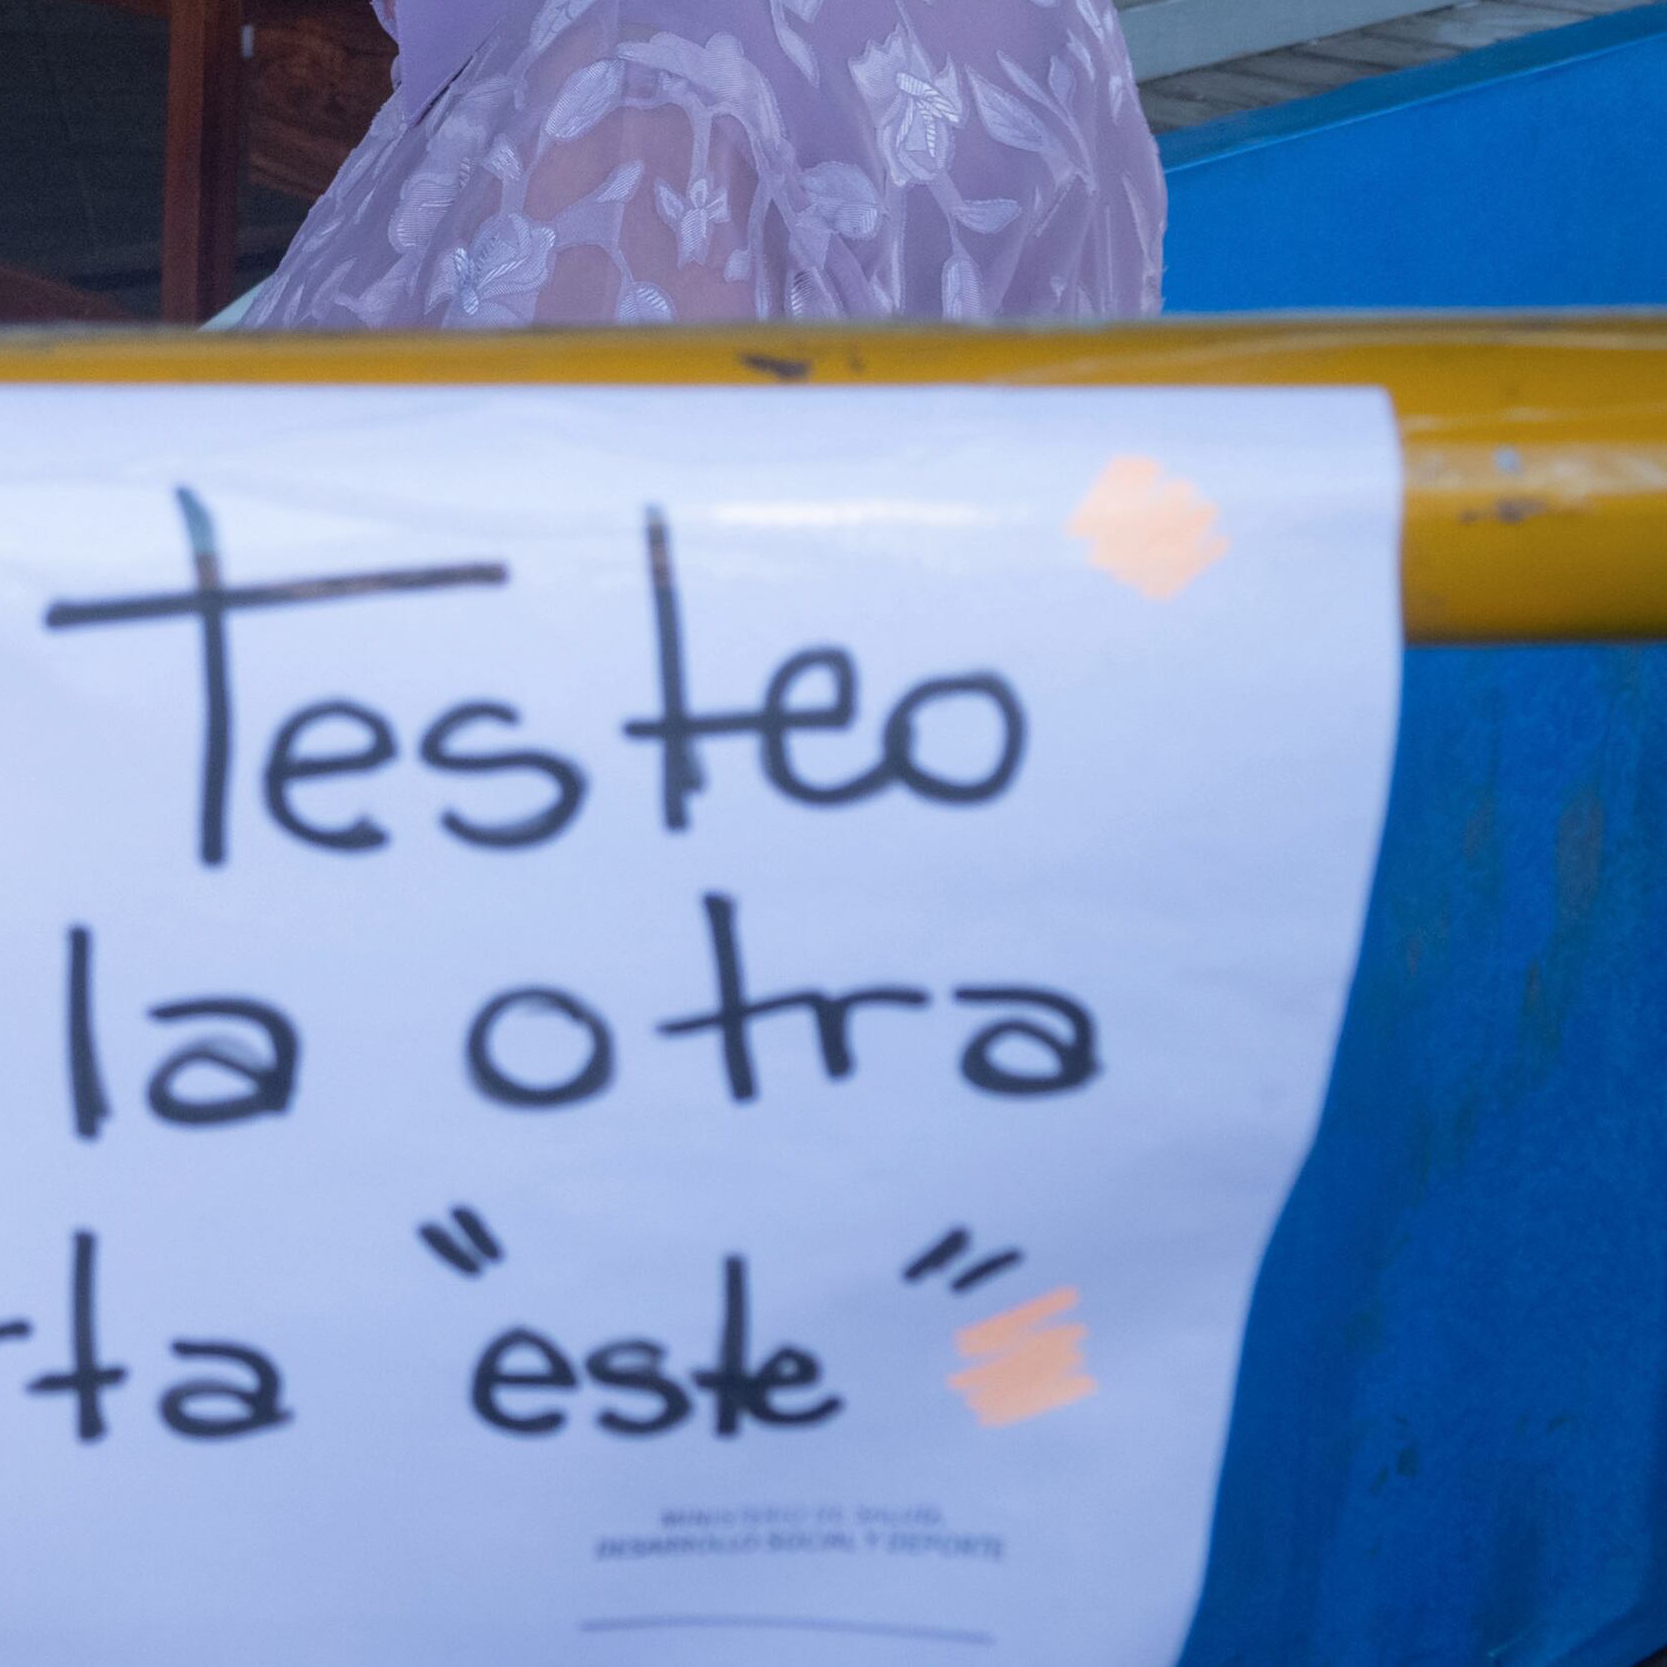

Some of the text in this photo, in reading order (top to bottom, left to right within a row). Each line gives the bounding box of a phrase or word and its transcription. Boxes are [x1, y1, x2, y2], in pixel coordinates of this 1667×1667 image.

[43, 484, 1030, 867] Testeo
[68, 924, 302, 1141] la
[463, 892, 1105, 1110] otra
